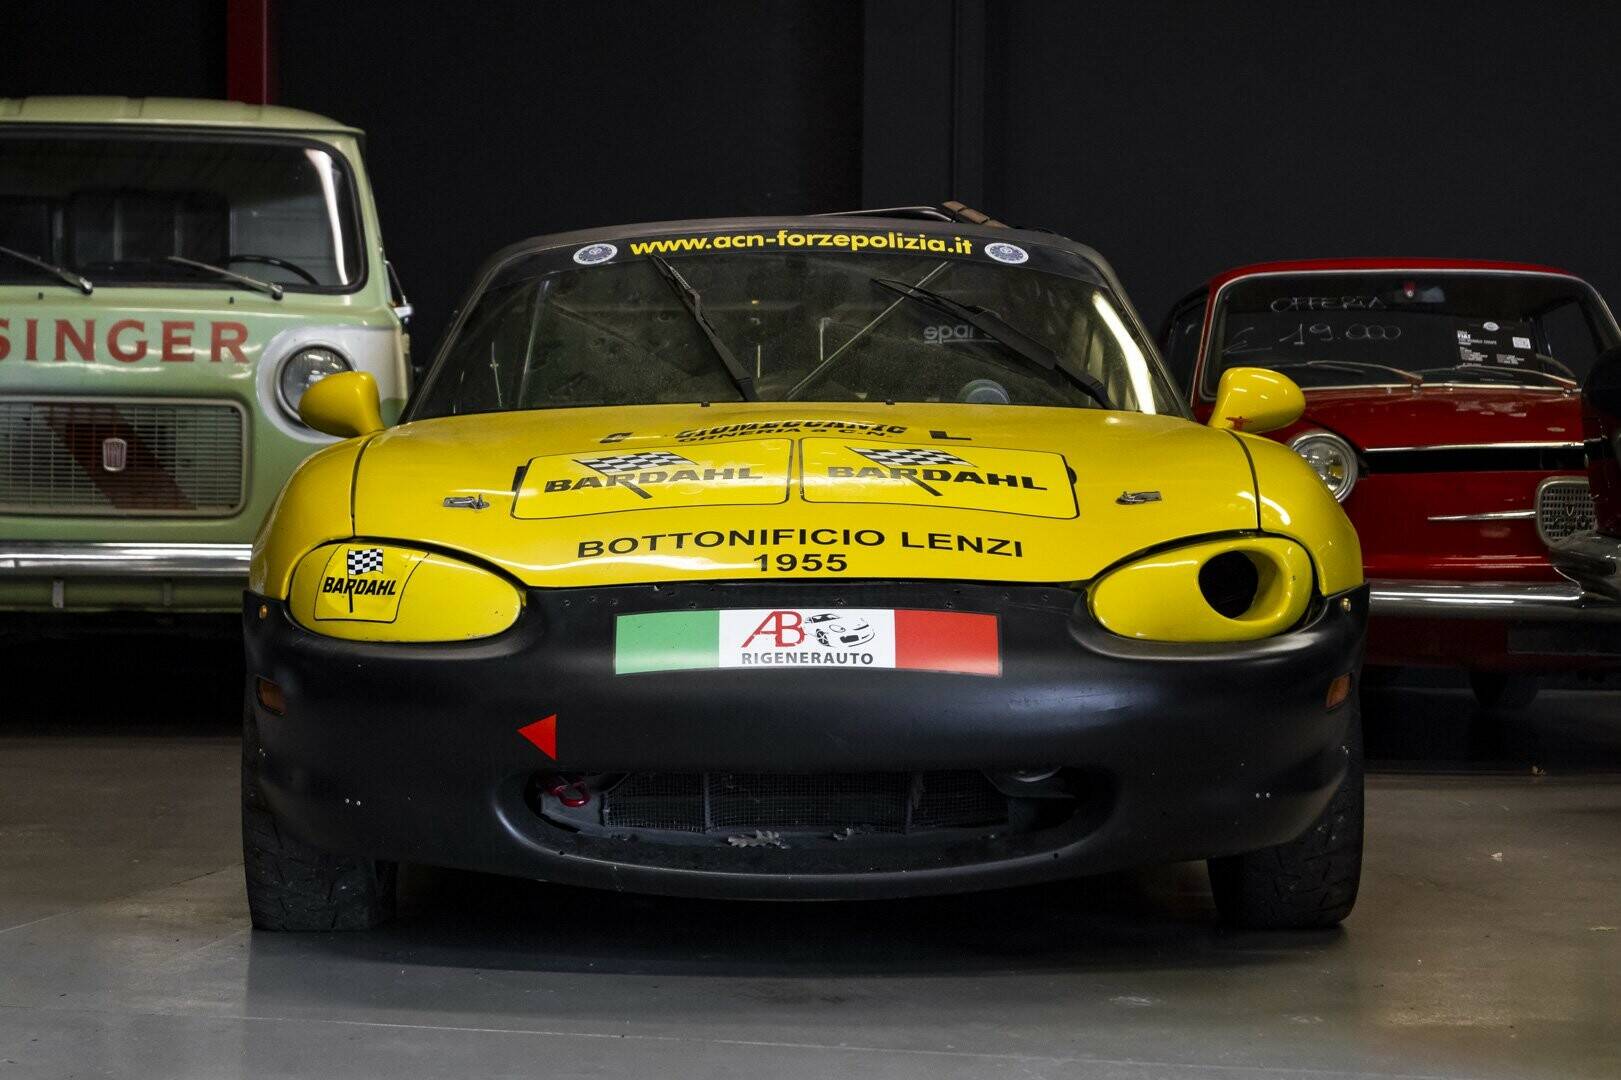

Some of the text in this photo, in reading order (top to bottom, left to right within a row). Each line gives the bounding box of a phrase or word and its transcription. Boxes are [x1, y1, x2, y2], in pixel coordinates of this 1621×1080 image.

[630, 230, 973, 254] www.acn-forzepolizia.it
[544, 468, 763, 498] BARDAHL
[828, 467, 1048, 496] BARDAHL
[577, 528, 1023, 558] BOTTONIFICIO LENZI
[753, 554, 848, 572] 1955
[322, 577, 397, 595] BARDAHL
[741, 610, 805, 648] AB
[741, 652, 874, 665] RIGENERAUTO
